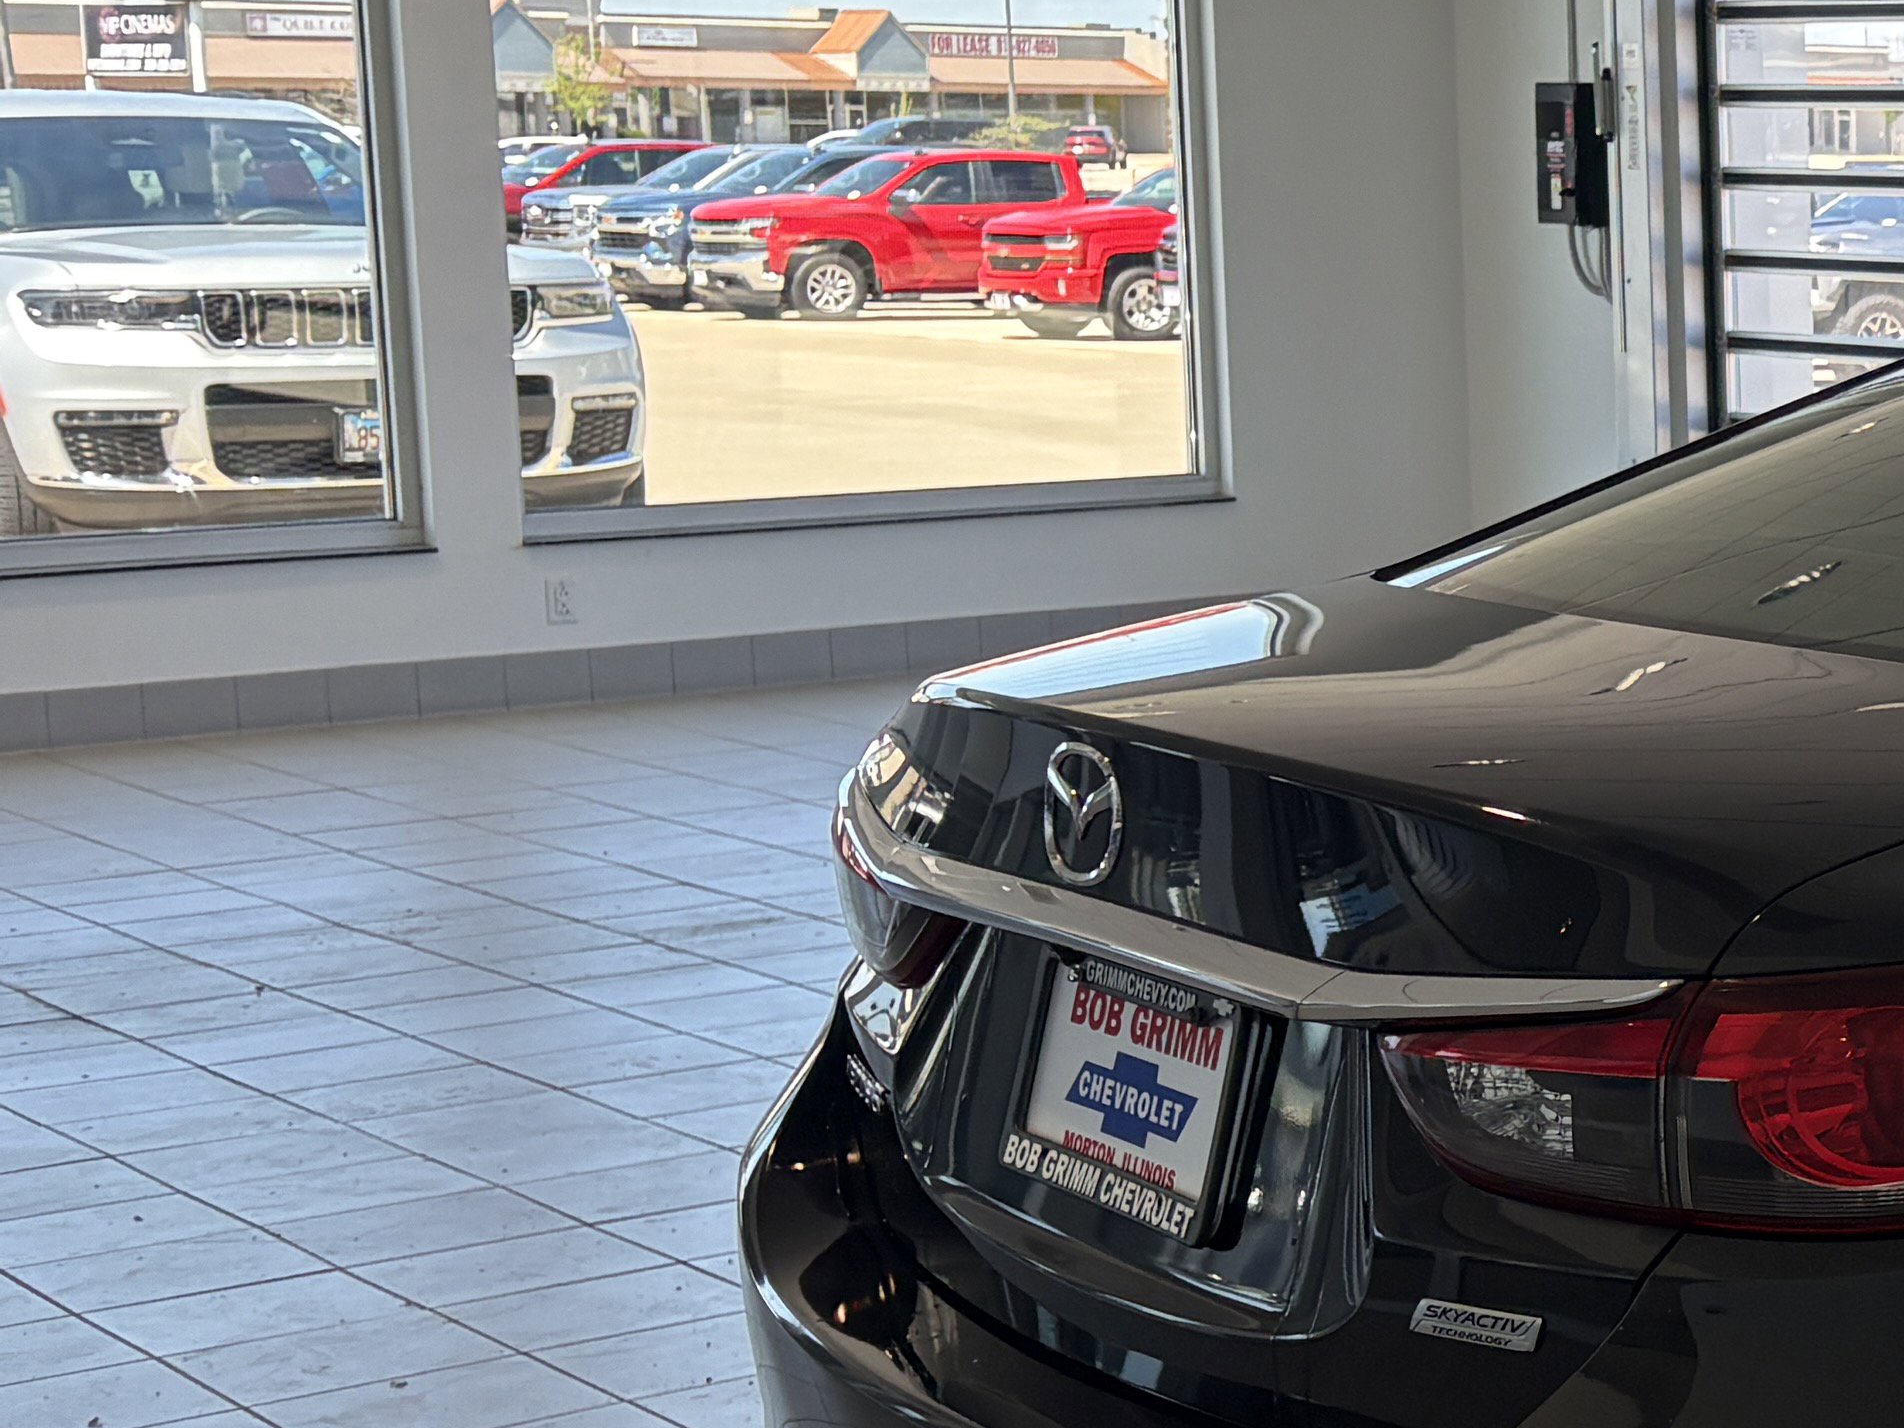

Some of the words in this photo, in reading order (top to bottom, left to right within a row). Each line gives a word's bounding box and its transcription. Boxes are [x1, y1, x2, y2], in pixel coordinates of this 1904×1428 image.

[1086, 960, 1197, 1012] GRIMMCHEVY.COM
[1071, 983, 1126, 1037] BOB
[1130, 1005, 1224, 1071] GRIMM
[1079, 1070, 1184, 1131] CHEVROLET
[1003, 1134, 1042, 1172] BOB
[1042, 1149, 1101, 1198] GRIMM
[1100, 1173, 1195, 1239] CHEVROLET
[1122, 1152, 1177, 1190] ILLINOIS
[1423, 1304, 1526, 1333] SKYACTIV
[1431, 1325, 1512, 1347] TECHNOLOGY
